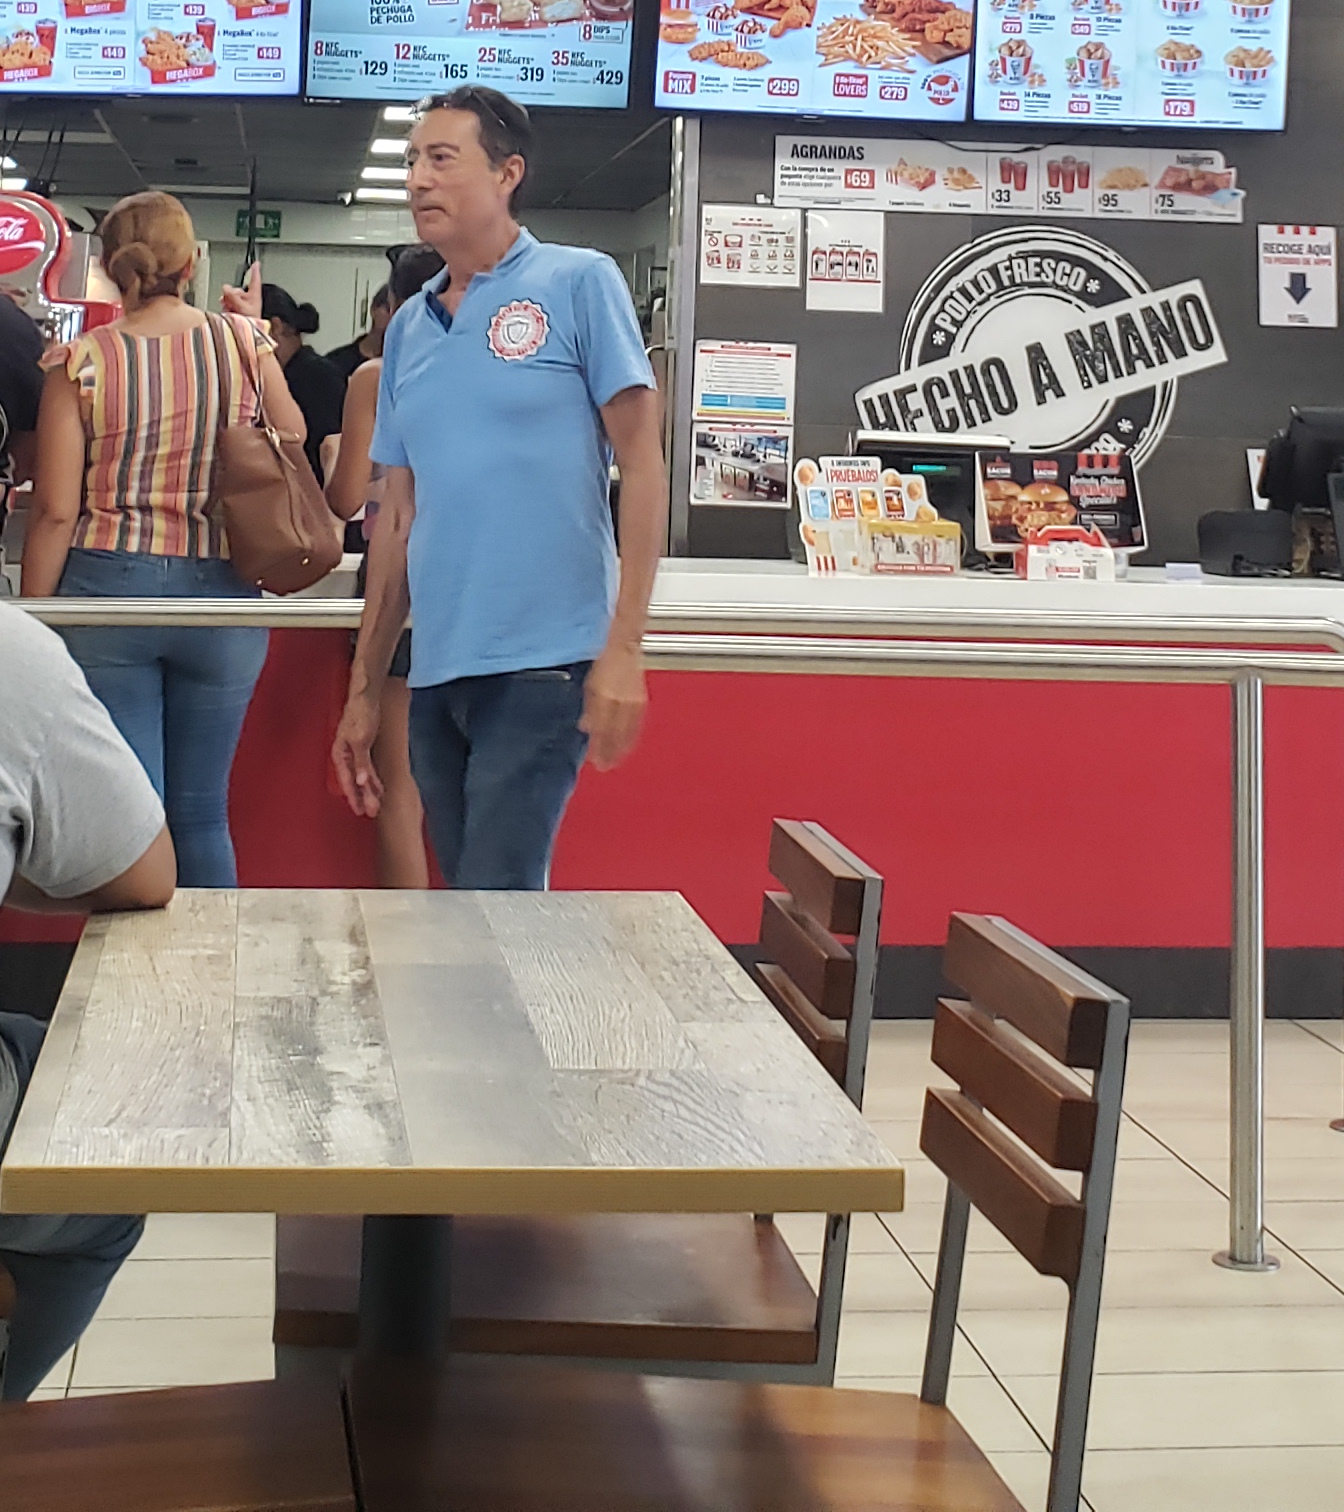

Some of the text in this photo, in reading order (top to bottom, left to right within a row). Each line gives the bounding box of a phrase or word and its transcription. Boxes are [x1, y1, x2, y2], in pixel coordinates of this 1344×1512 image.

[370, 5, 414, 16] PECHUGA
[370, 13, 415, 25] DE POLLO
[582, 23, 611, 42] 8 DIPS
[259, 47, 280, 59] $149
[313, 39, 340, 56] 8 KFC
[394, 43, 427, 60] 12 KFC
[478, 47, 512, 63] 25 KFC
[551, 50, 586, 66] 35 KFC
[166, 67, 204, 81] MEGABOX
[359, 60, 388, 76] $129
[440, 63, 469, 79] $165
[516, 66, 545, 82] $319
[592, 69, 624, 85] $429
[668, 78, 692, 94] MIX
[769, 79, 799, 95] $299
[834, 83, 867, 96] LOVERS
[881, 86, 905, 100] $279
[790, 143, 865, 161] AGRANDAS
[780, 164, 791, 172] Con
[798, 166, 819, 174] compra
[991, 190, 1175, 208] $33 $55 $95 $75
[1262, 242, 1304, 255] RECOGE
[935, 256, 1088, 333] POLLO FRESCO
[862, 356, 1019, 433] HECHO
[1025, 341, 1066, 406] A
[1064, 293, 1214, 390] MANO
